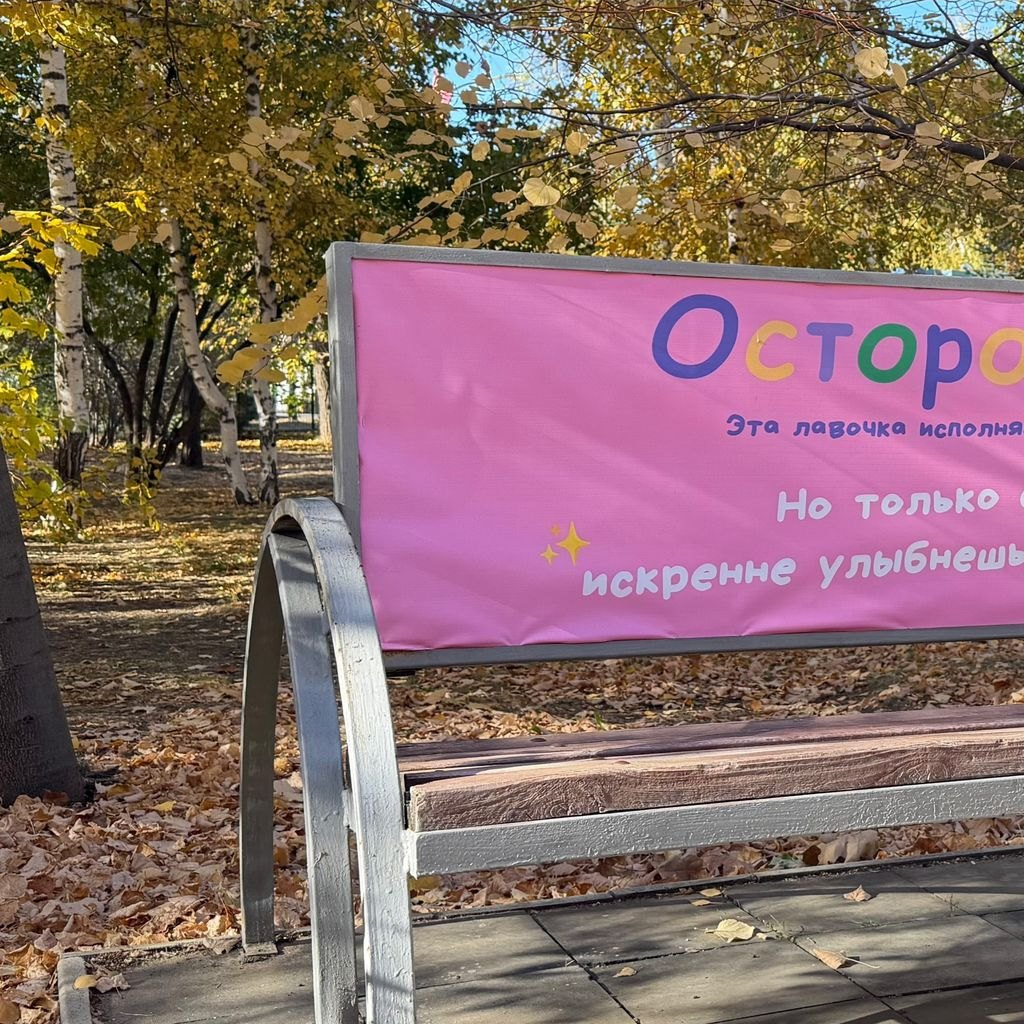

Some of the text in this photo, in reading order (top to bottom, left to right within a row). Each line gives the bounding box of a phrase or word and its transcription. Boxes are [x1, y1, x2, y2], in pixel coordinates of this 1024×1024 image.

[726, 414, 779, 439] Эта
[793, 419, 906, 439] лавочка
[777, 489, 831, 523] Но
[856, 487, 999, 520] только
[582, 557, 797, 601] искренне
